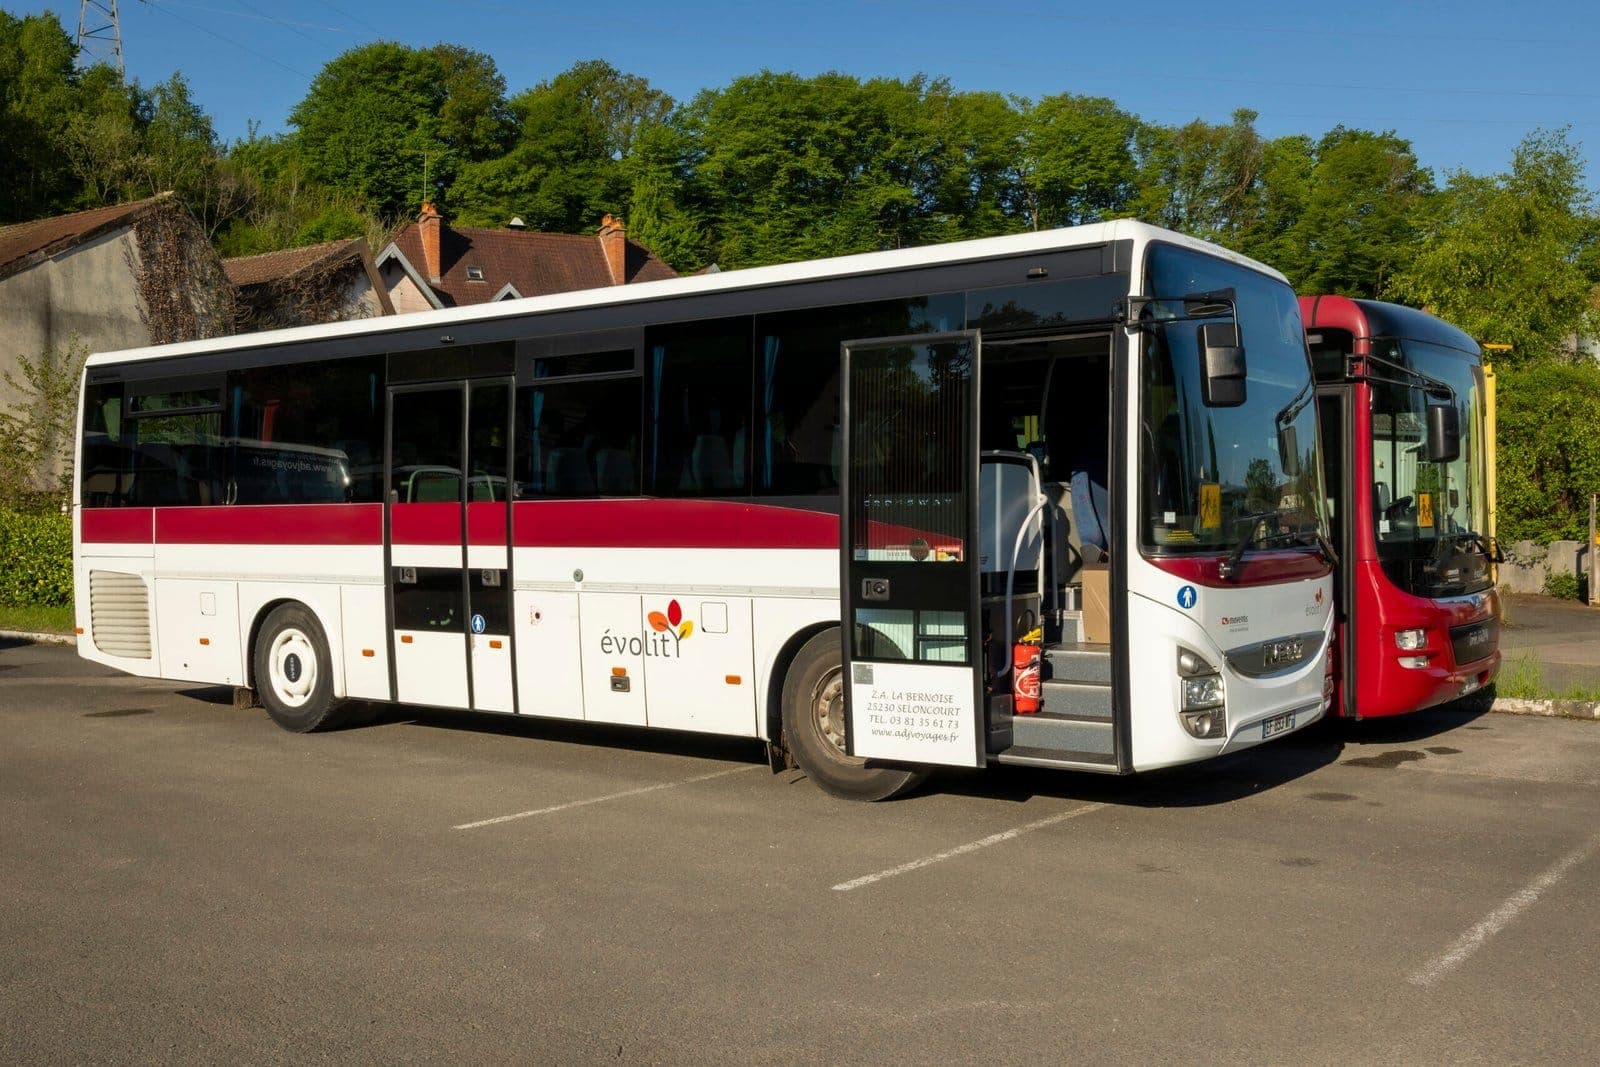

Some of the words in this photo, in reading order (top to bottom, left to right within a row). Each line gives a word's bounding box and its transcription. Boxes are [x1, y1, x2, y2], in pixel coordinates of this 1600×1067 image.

[871, 690, 888, 699] Z.A.
[892, 691, 903, 700] LA
[906, 692, 954, 703] BERNOISE
[867, 702, 895, 711] 25230
[897, 704, 961, 716] SELONCOURT
[889, 716, 902, 725] 03
[904, 716, 915, 726] 81
[919, 717, 930, 727] 35
[932, 718, 944, 729] 61
[948, 719, 959, 730] 73
[871, 729, 959, 742] www.adjvoyages.fr
